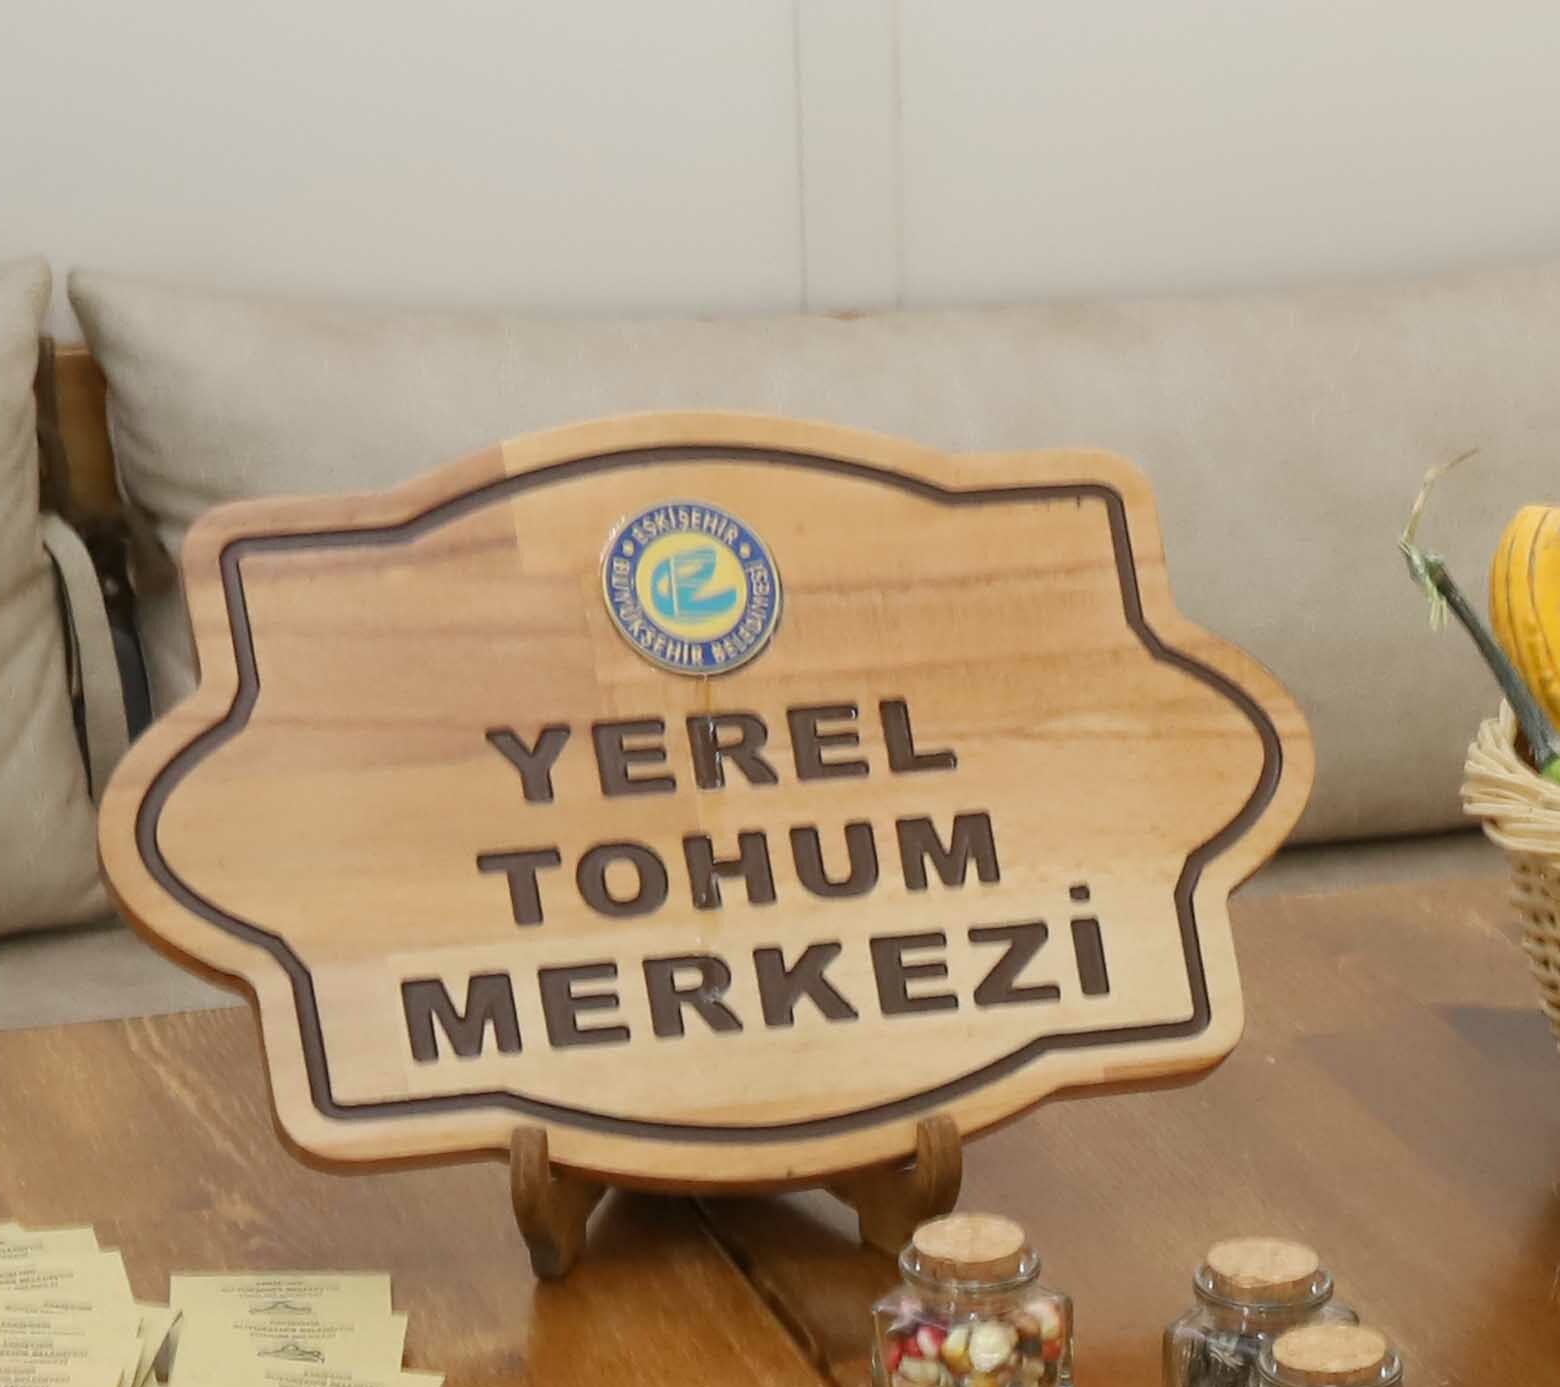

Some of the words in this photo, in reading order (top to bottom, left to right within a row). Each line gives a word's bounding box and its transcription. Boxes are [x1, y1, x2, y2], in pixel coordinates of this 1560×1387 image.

[485, 695, 958, 803] YEREL
[476, 811, 1001, 926] TOHUM
[401, 884, 1110, 1063] MERKEZİ
